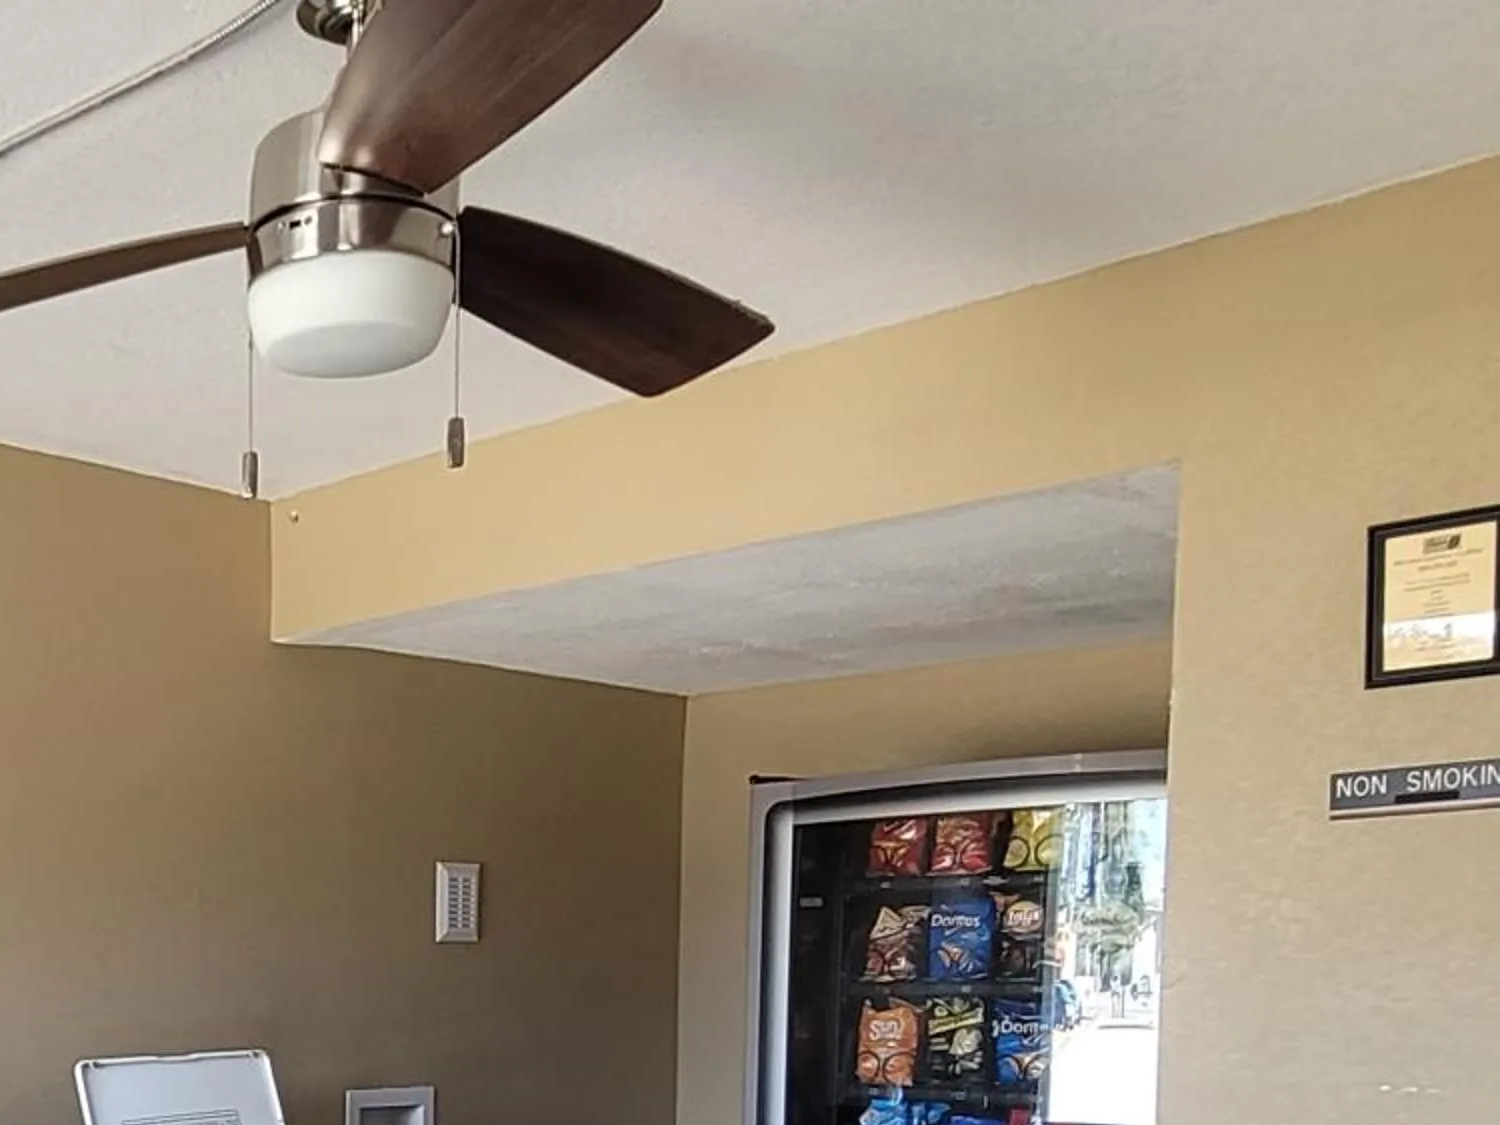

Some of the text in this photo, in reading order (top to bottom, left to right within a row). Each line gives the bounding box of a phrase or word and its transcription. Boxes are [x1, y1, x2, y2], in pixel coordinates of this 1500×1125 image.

[1336, 764, 1500, 798] NON SMOKIN
[931, 914, 980, 927] Doritos
